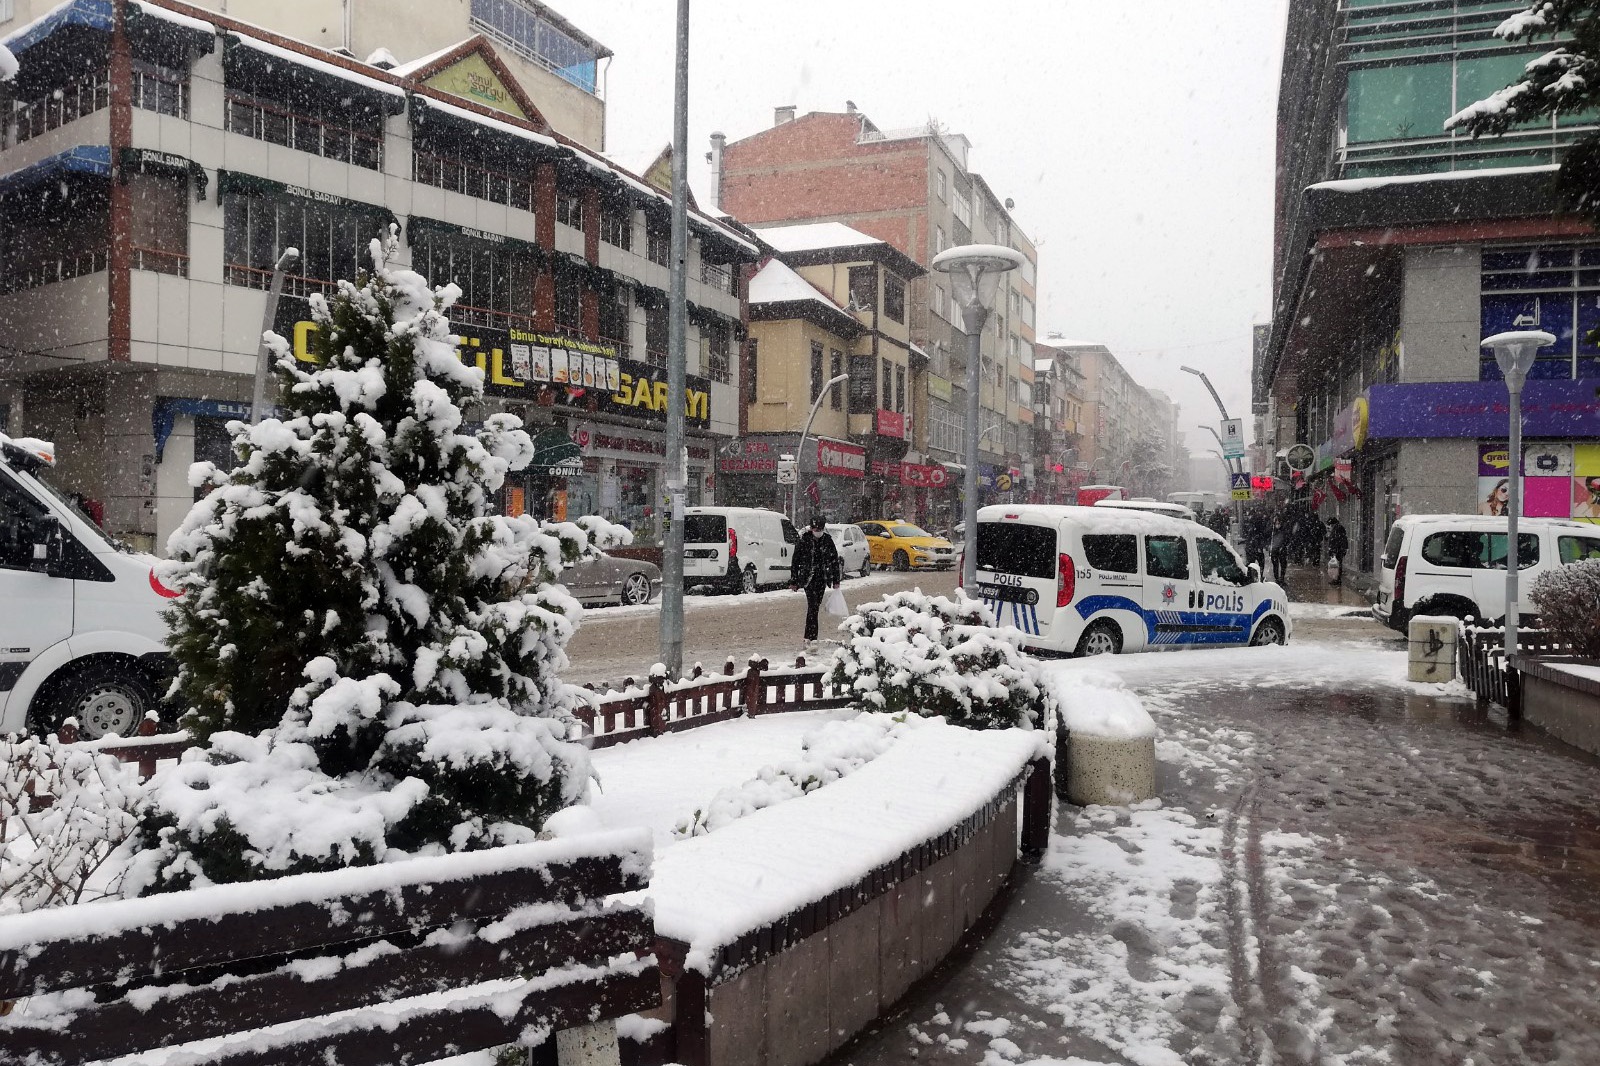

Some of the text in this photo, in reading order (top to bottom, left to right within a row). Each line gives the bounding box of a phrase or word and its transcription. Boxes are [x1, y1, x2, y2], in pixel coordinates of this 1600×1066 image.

[612, 372, 708, 420] SARYI
[1486, 453, 1510, 463] grati
[993, 573, 1023, 587] POLİS
[1076, 568, 1092, 580] 155
[1206, 590, 1244, 613] POLİS
